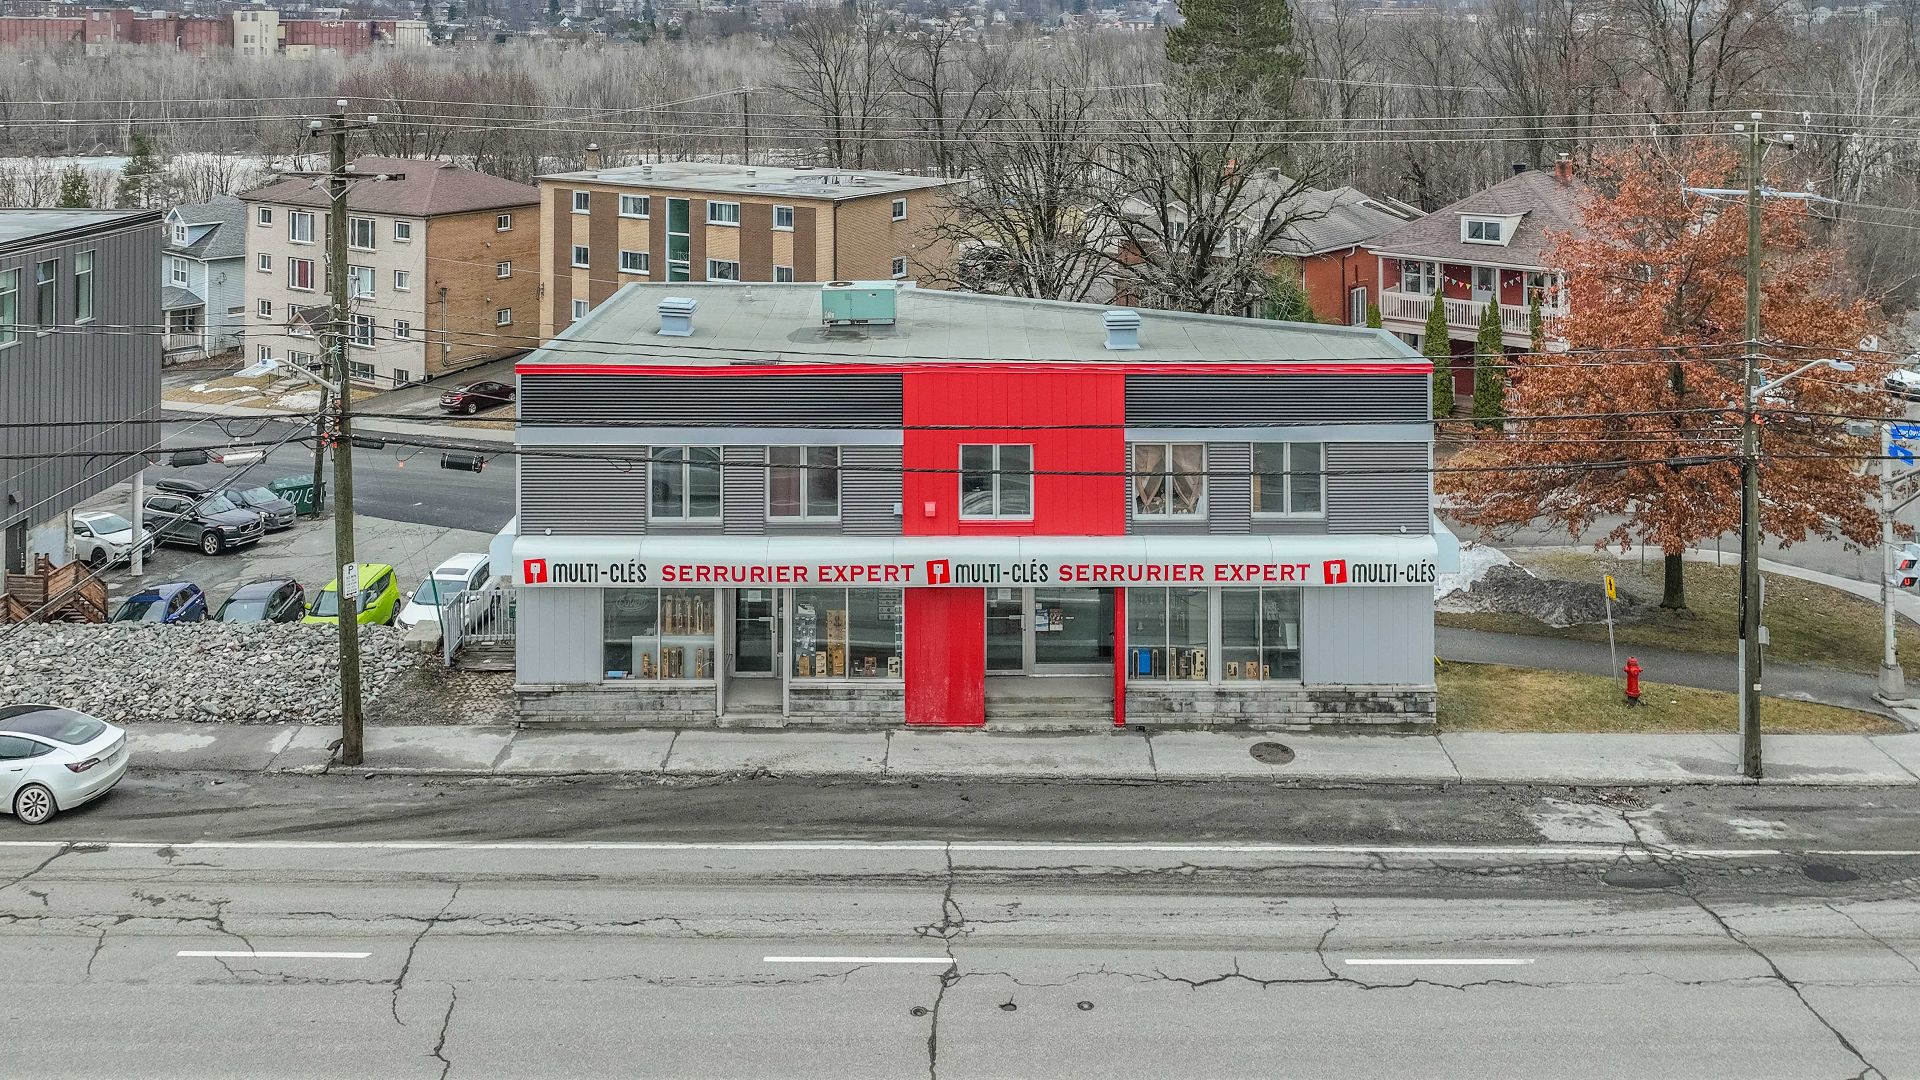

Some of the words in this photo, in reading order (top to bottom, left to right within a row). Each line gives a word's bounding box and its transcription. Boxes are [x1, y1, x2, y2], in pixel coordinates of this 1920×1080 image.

[552, 559, 648, 583] MULTI-CLÉS
[661, 564, 809, 583] SERRURIER
[818, 564, 915, 583] EXPERT
[955, 559, 1049, 583] MULTI-CLÉS
[1058, 564, 1205, 582] SERRURIER
[1214, 563, 1311, 582] EXPERT
[1352, 558, 1436, 583] MULTI-CLÉS
